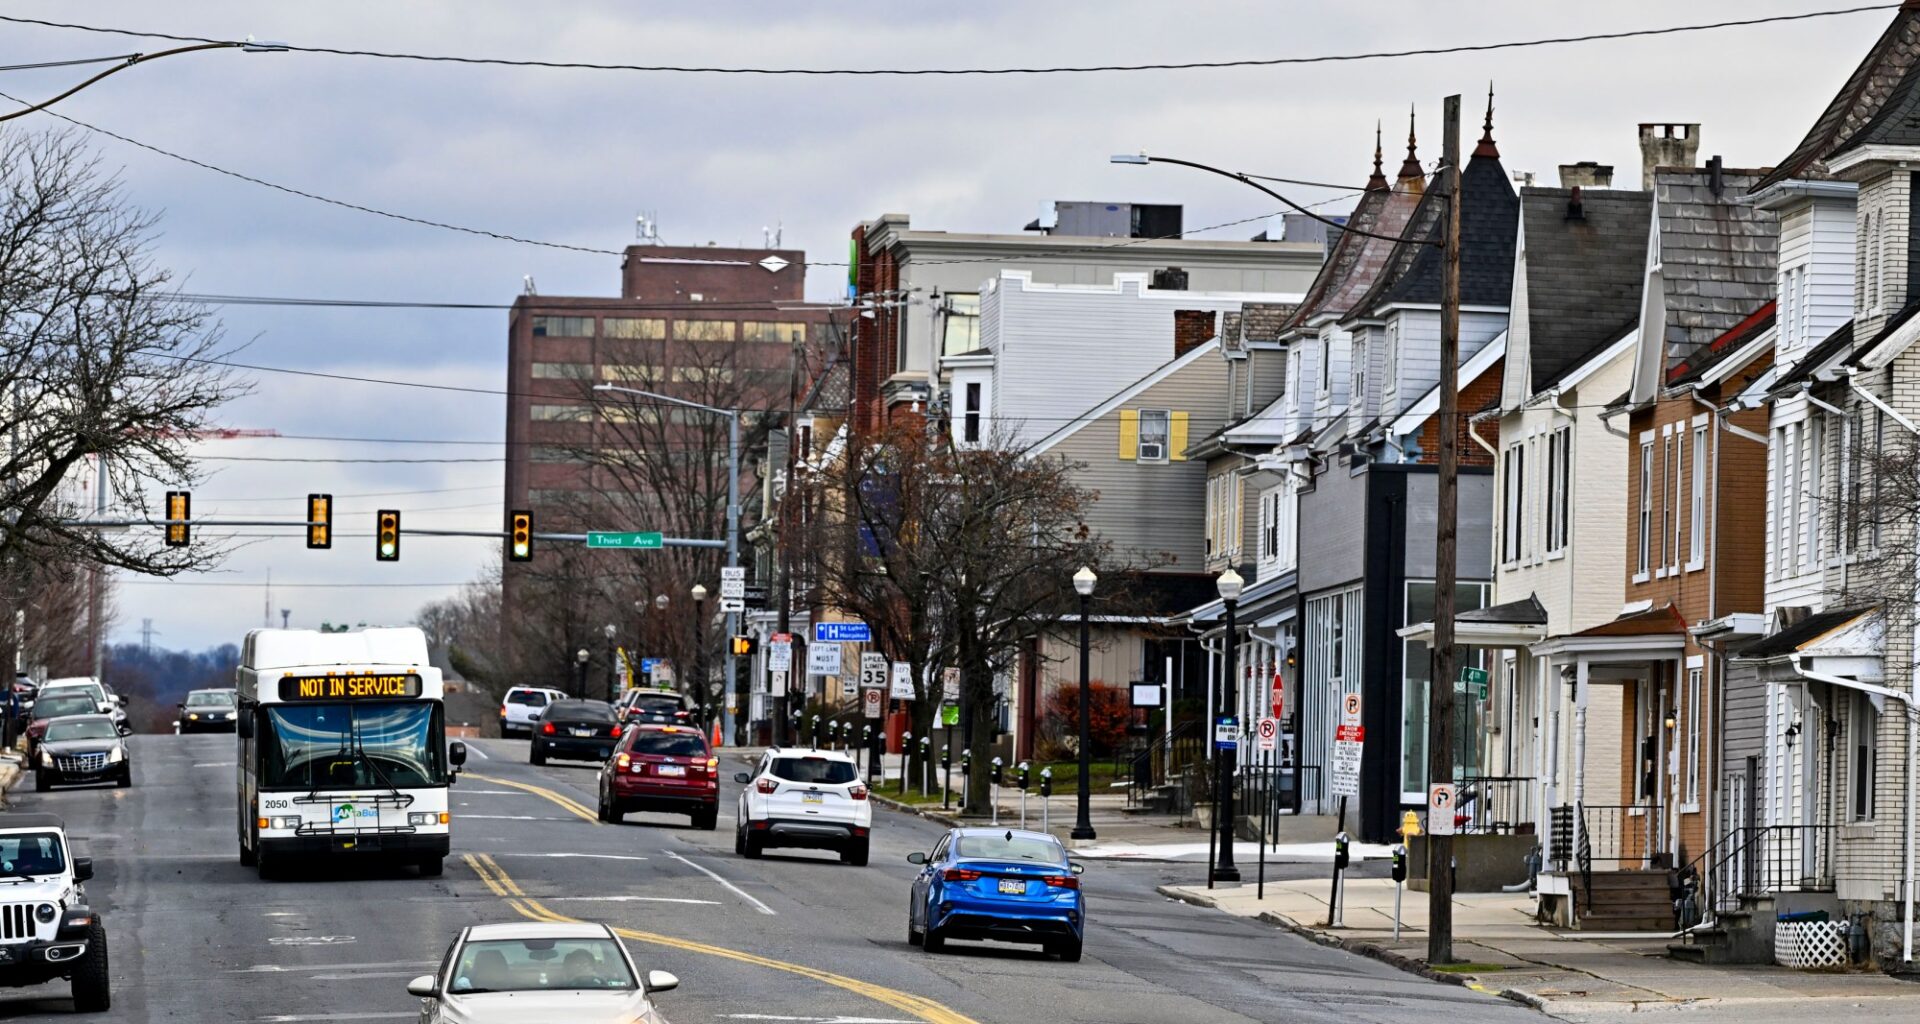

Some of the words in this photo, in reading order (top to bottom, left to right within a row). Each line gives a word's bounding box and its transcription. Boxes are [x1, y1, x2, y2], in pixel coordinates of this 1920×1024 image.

[596, 535, 622, 545] Third
[633, 535, 653, 545] Ave
[863, 671, 886, 684] 35
[300, 678, 324, 697] NOT
[329, 678, 345, 696] IN
[348, 677, 405, 696] SERVICE
[1273, 688, 1283, 705] STOP
[265, 799, 288, 809] 2050
